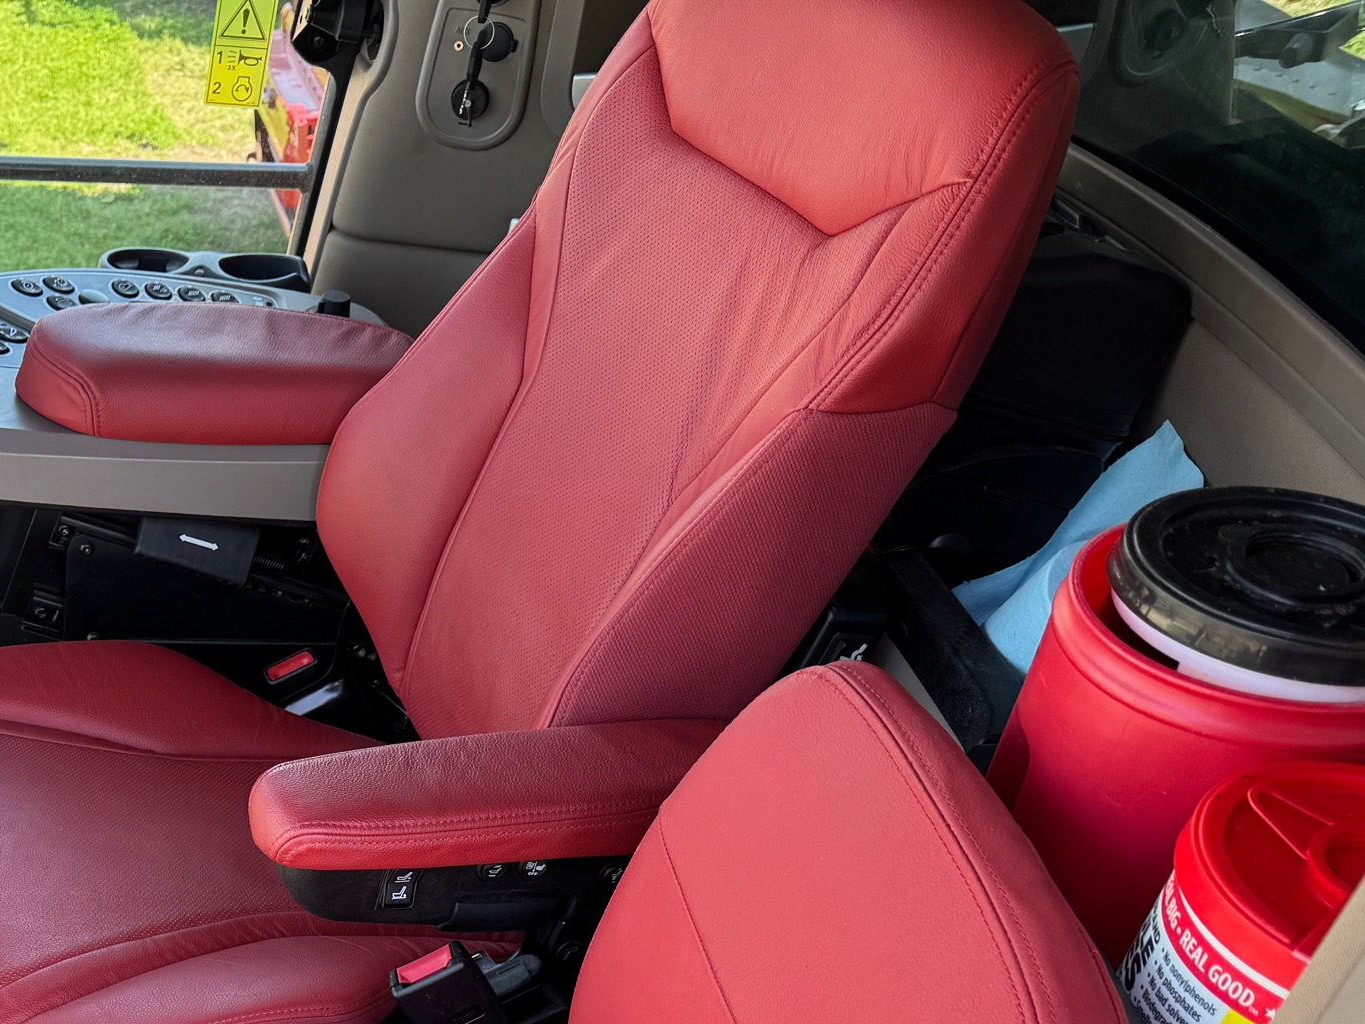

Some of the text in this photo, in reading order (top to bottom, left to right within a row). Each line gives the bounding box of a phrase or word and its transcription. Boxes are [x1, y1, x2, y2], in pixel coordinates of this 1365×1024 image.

[216, 50, 223, 65] 1
[212, 81, 222, 95] 2
[1166, 897, 1181, 930] BIG
[1179, 928, 1208, 973] REAL
[1208, 964, 1255, 1007] GOOD
[1148, 975, 1157, 992] No
[1154, 986, 1169, 1007] bad
[1155, 964, 1202, 1023] No phosphates
[1163, 950, 1217, 1016] No nonylphenols
